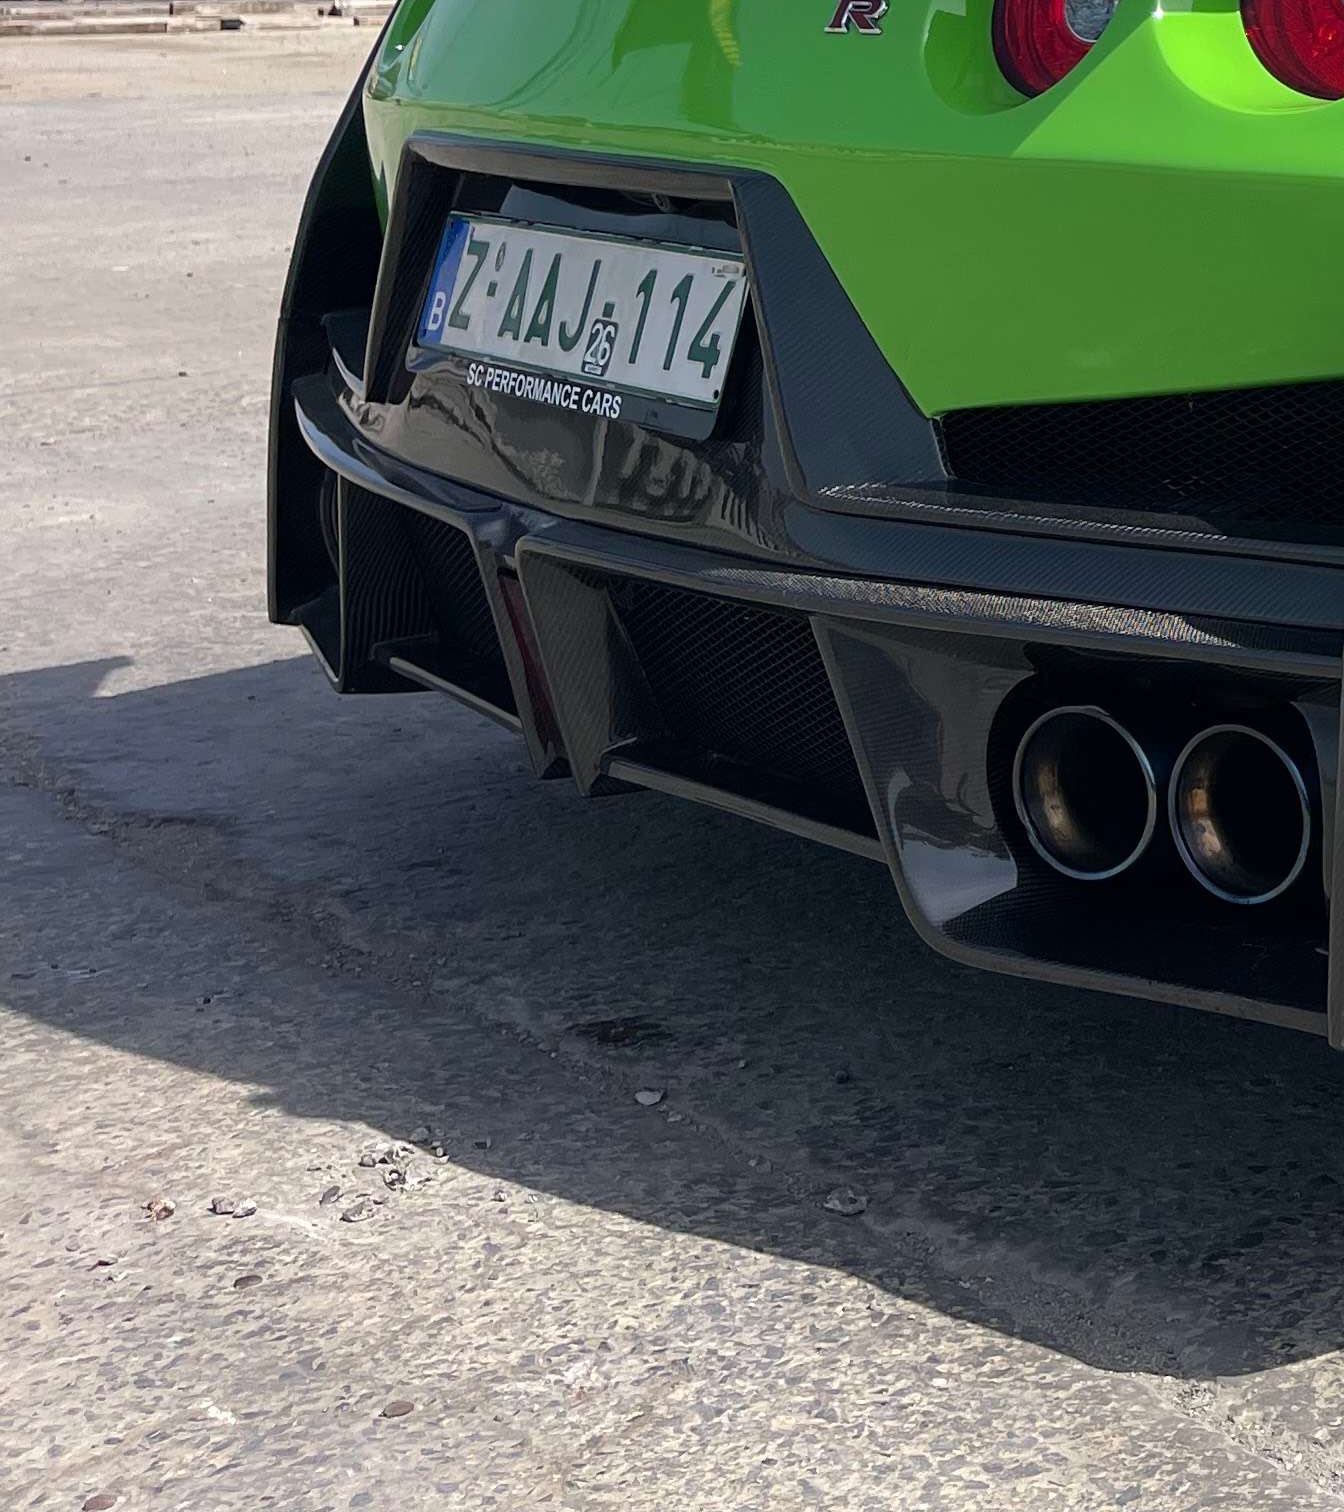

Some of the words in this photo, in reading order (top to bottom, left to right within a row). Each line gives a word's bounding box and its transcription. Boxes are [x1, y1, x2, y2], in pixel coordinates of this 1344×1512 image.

[427, 291, 446, 330] B
[584, 322, 616, 366] 26
[466, 363, 484, 387] SC
[484, 368, 581, 410] PERFORMANCE
[581, 390, 622, 419] CARS
